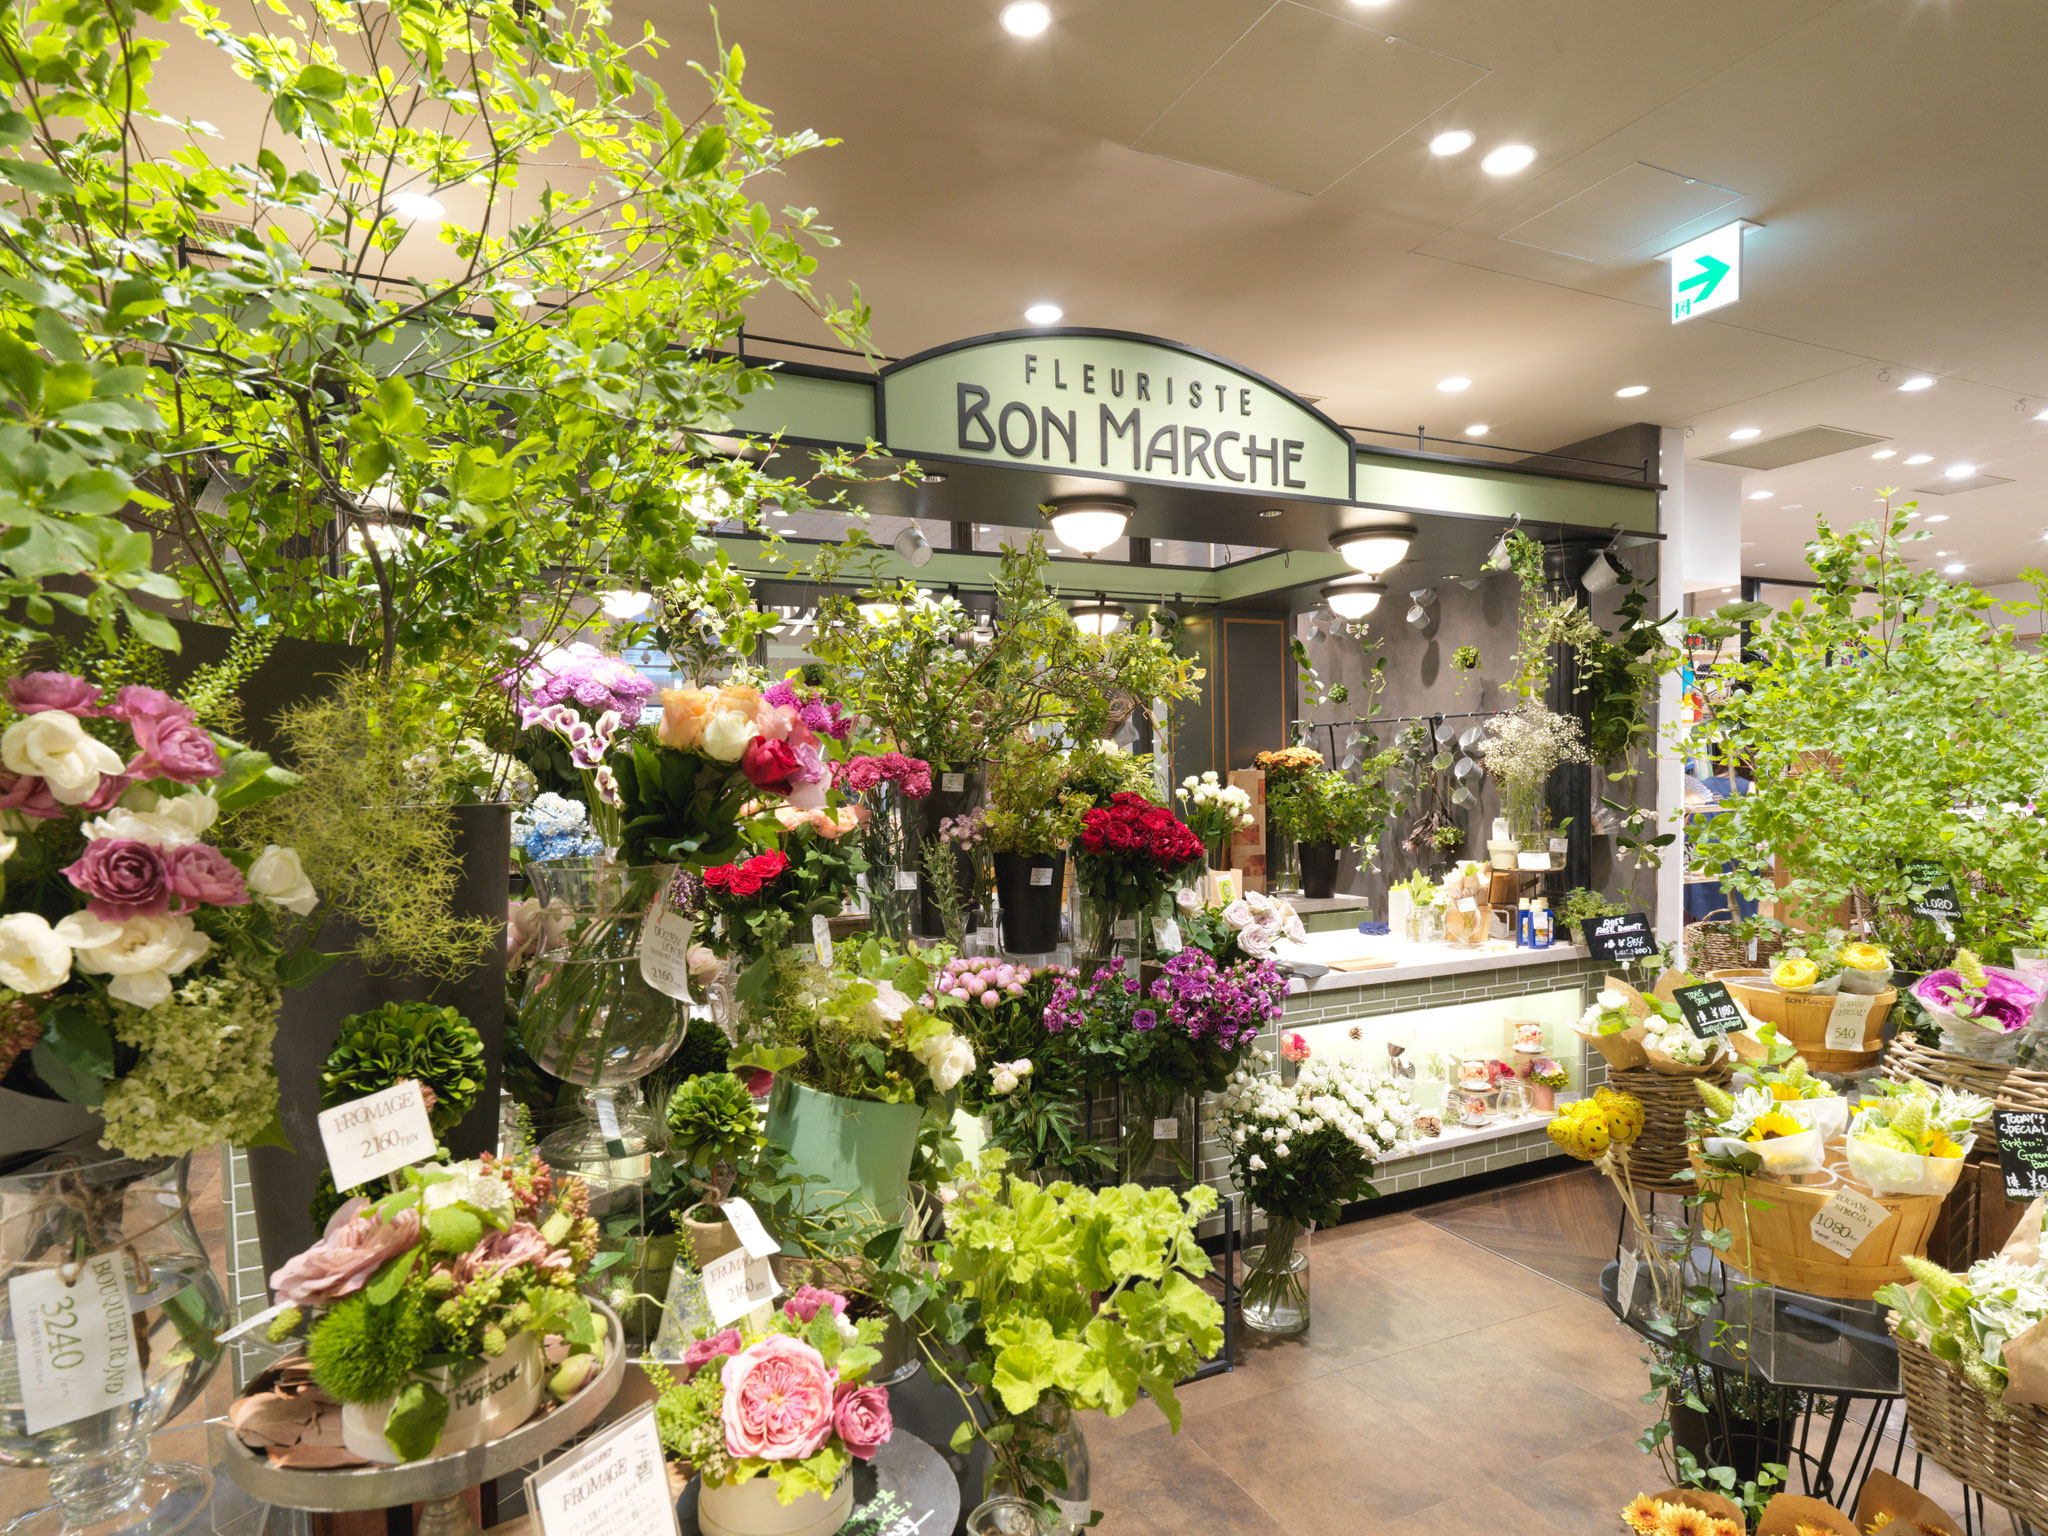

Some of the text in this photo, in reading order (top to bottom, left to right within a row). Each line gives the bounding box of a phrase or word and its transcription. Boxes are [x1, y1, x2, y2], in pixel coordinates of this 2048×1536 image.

[1025, 354, 1251, 416] FLEURISTE
[957, 382, 1307, 488] BON MARCHE
[651, 967, 674, 982] 2160
[1834, 1027, 1856, 1040] 540
[333, 1091, 414, 1134] FROMAGE
[360, 1128, 400, 1159] 2160
[1999, 1123, 2048, 1137] SPECIAL
[1815, 1213, 1852, 1238] 1080
[710, 1258, 760, 1283] FROMAG
[91, 1258, 129, 1342] BOUQUET
[727, 1277, 754, 1303] 2160
[40, 1295, 85, 1370] 3240
[562, 1457, 628, 1512] FROMAGE
